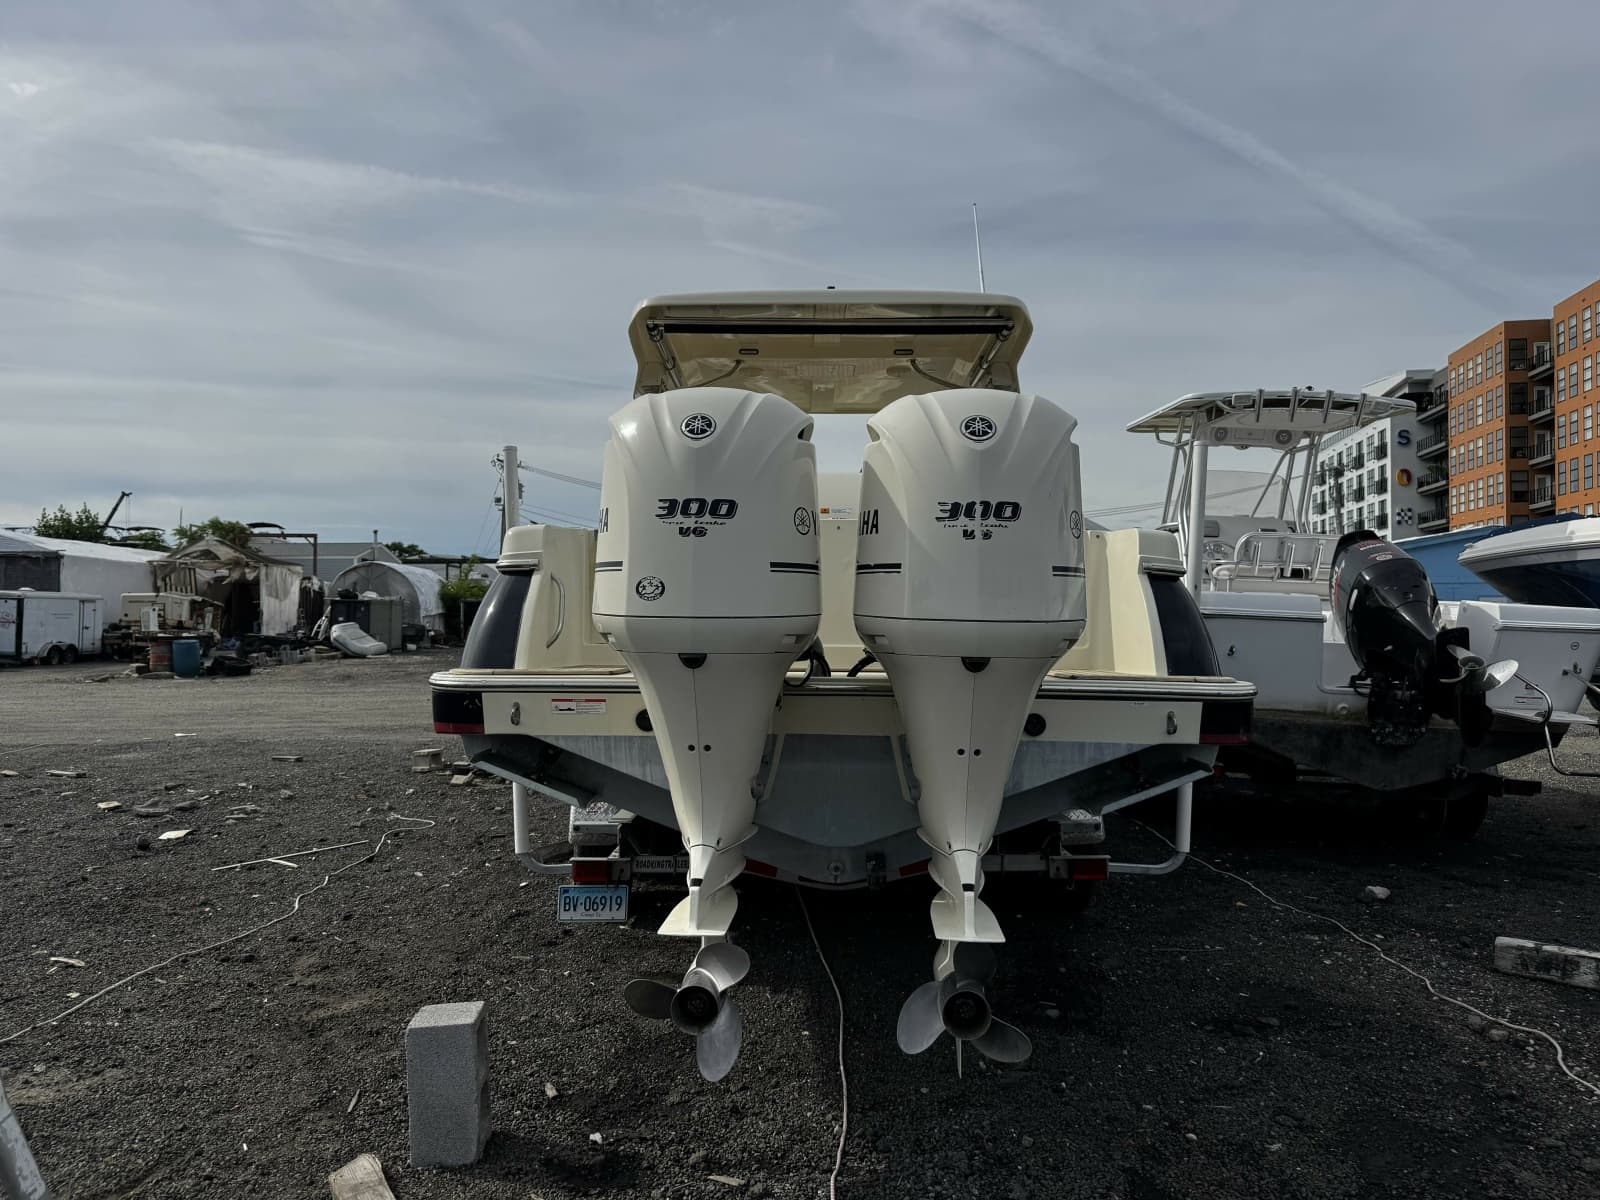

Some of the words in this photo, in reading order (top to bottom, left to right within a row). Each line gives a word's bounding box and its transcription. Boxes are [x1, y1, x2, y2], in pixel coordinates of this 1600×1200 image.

[655, 498, 739, 519] 300
[935, 500, 1022, 522] 300
[859, 509, 879, 536] HA
